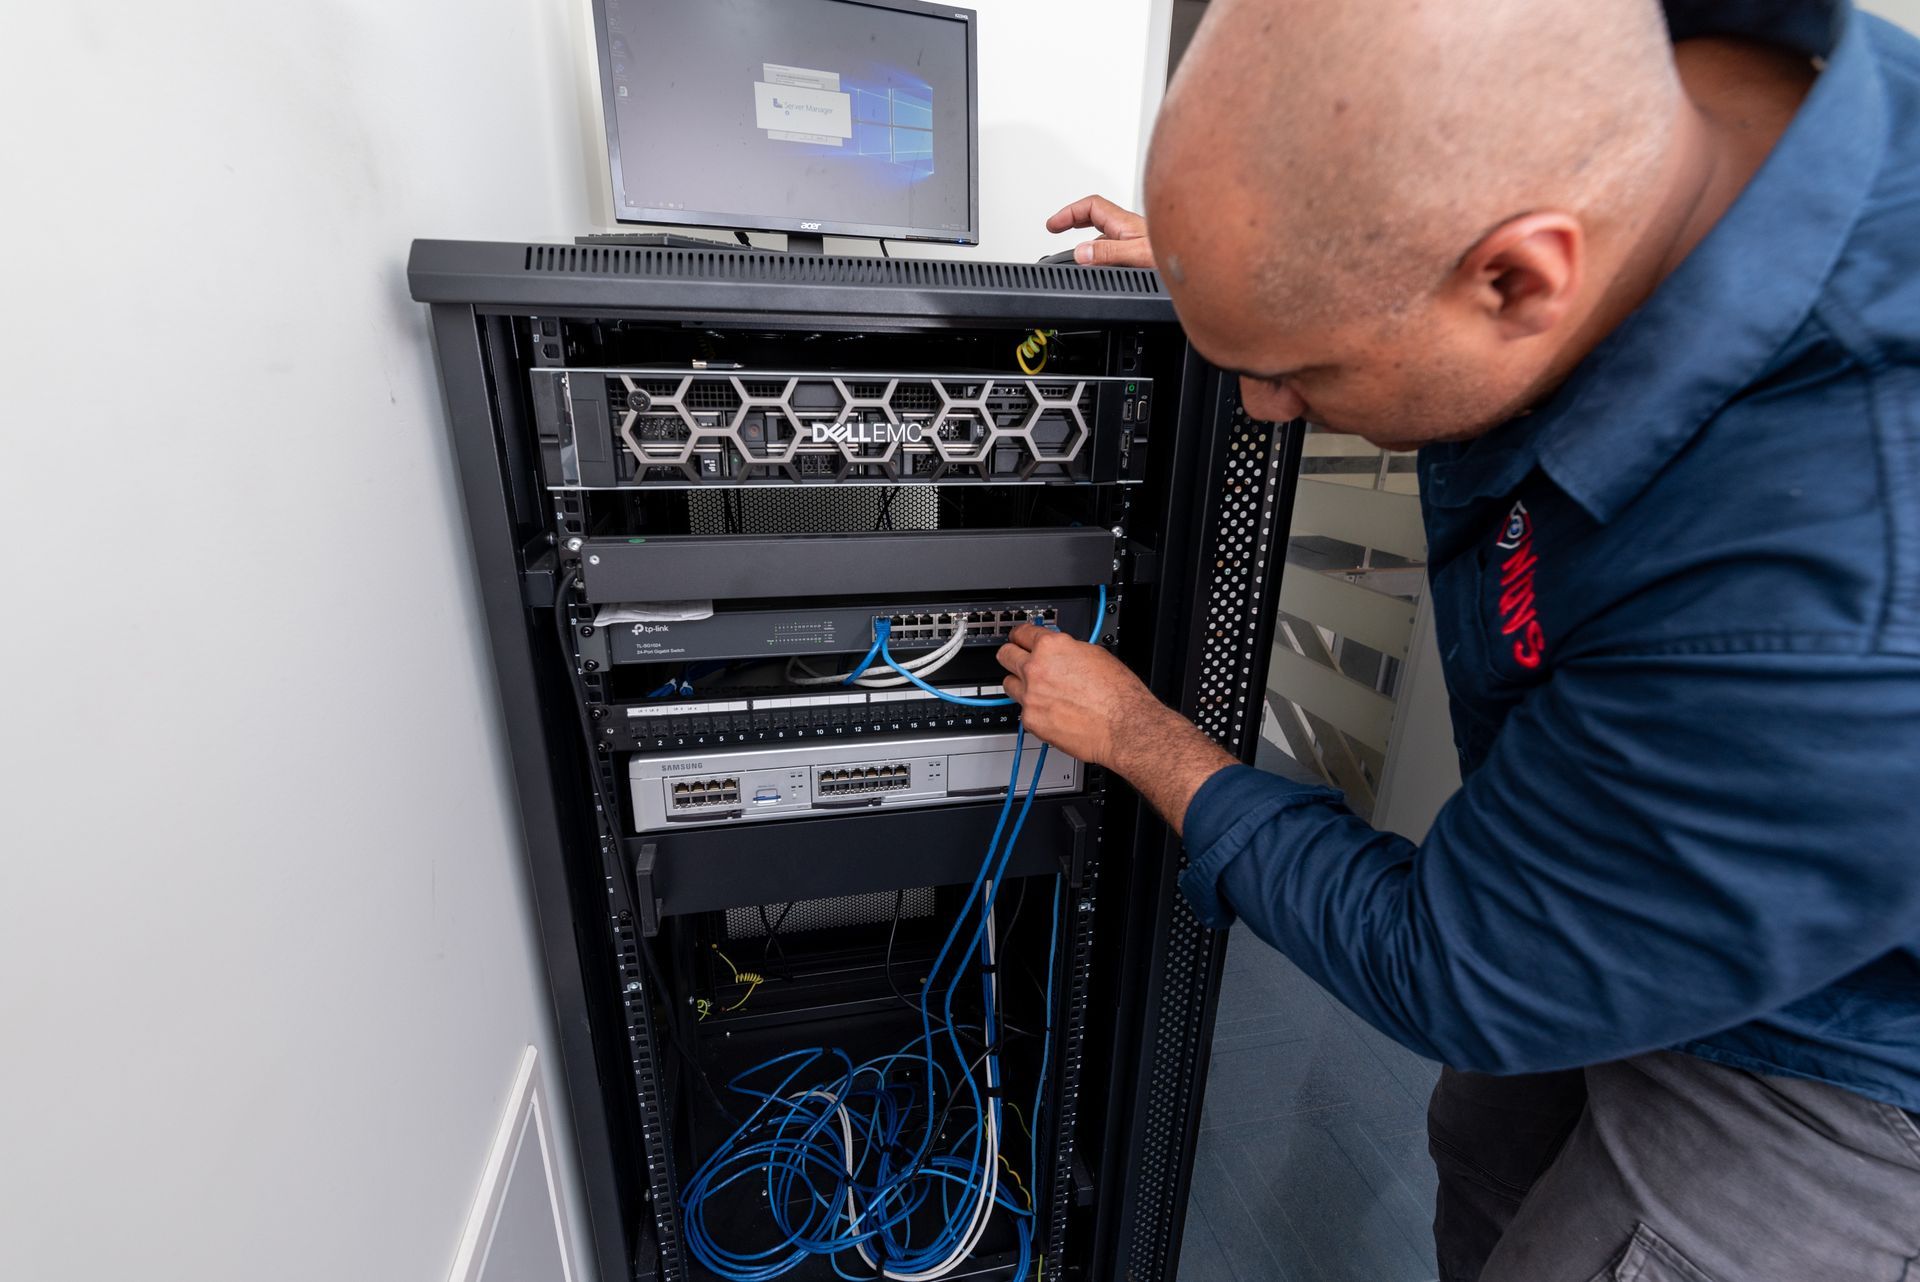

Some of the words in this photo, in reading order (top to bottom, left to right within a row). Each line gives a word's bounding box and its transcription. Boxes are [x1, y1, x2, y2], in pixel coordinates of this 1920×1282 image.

[784, 101, 805, 111] Server
[805, 105, 833, 115] Manager
[800, 222, 821, 230] acer
[661, 763, 703, 772] SAMSUNG
